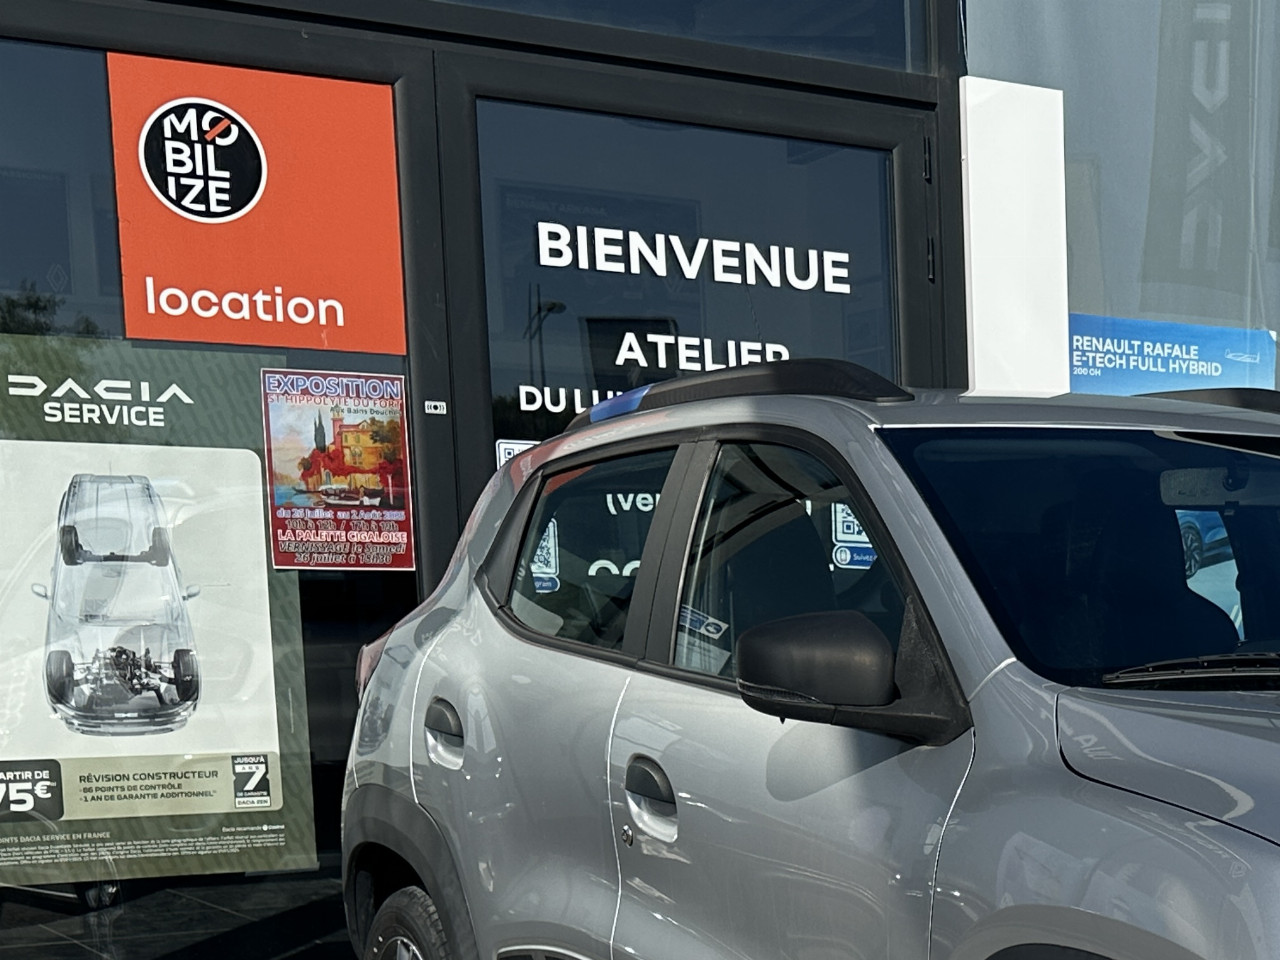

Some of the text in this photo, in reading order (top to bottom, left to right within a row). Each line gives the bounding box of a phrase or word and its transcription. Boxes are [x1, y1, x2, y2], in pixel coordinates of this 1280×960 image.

[165, 140, 230, 177] BIL
[168, 176, 231, 212] IZE
[537, 221, 851, 294] BIENVENUE
[145, 277, 345, 326] location
[1072, 335, 1199, 360] RENAULT RAFALE
[1072, 351, 1222, 377] E-TECH FULL HYBRID
[1073, 367, 1088, 376] 200
[8, 375, 194, 403] DACIA
[266, 374, 402, 399] EXPOSITION
[519, 385, 566, 413] DU
[285, 394, 349, 407] HIPPOLYTE
[354, 397, 369, 407] DU
[44, 402, 165, 426] SERVICE
[278, 529, 407, 543] LA PALETTE CIGALOISE
[34, 770, 49, 779] DE
[79, 770, 219, 783] RÉVISION CONSTRUCTEUR
[139, 783, 182, 791] CONTRÔLE
